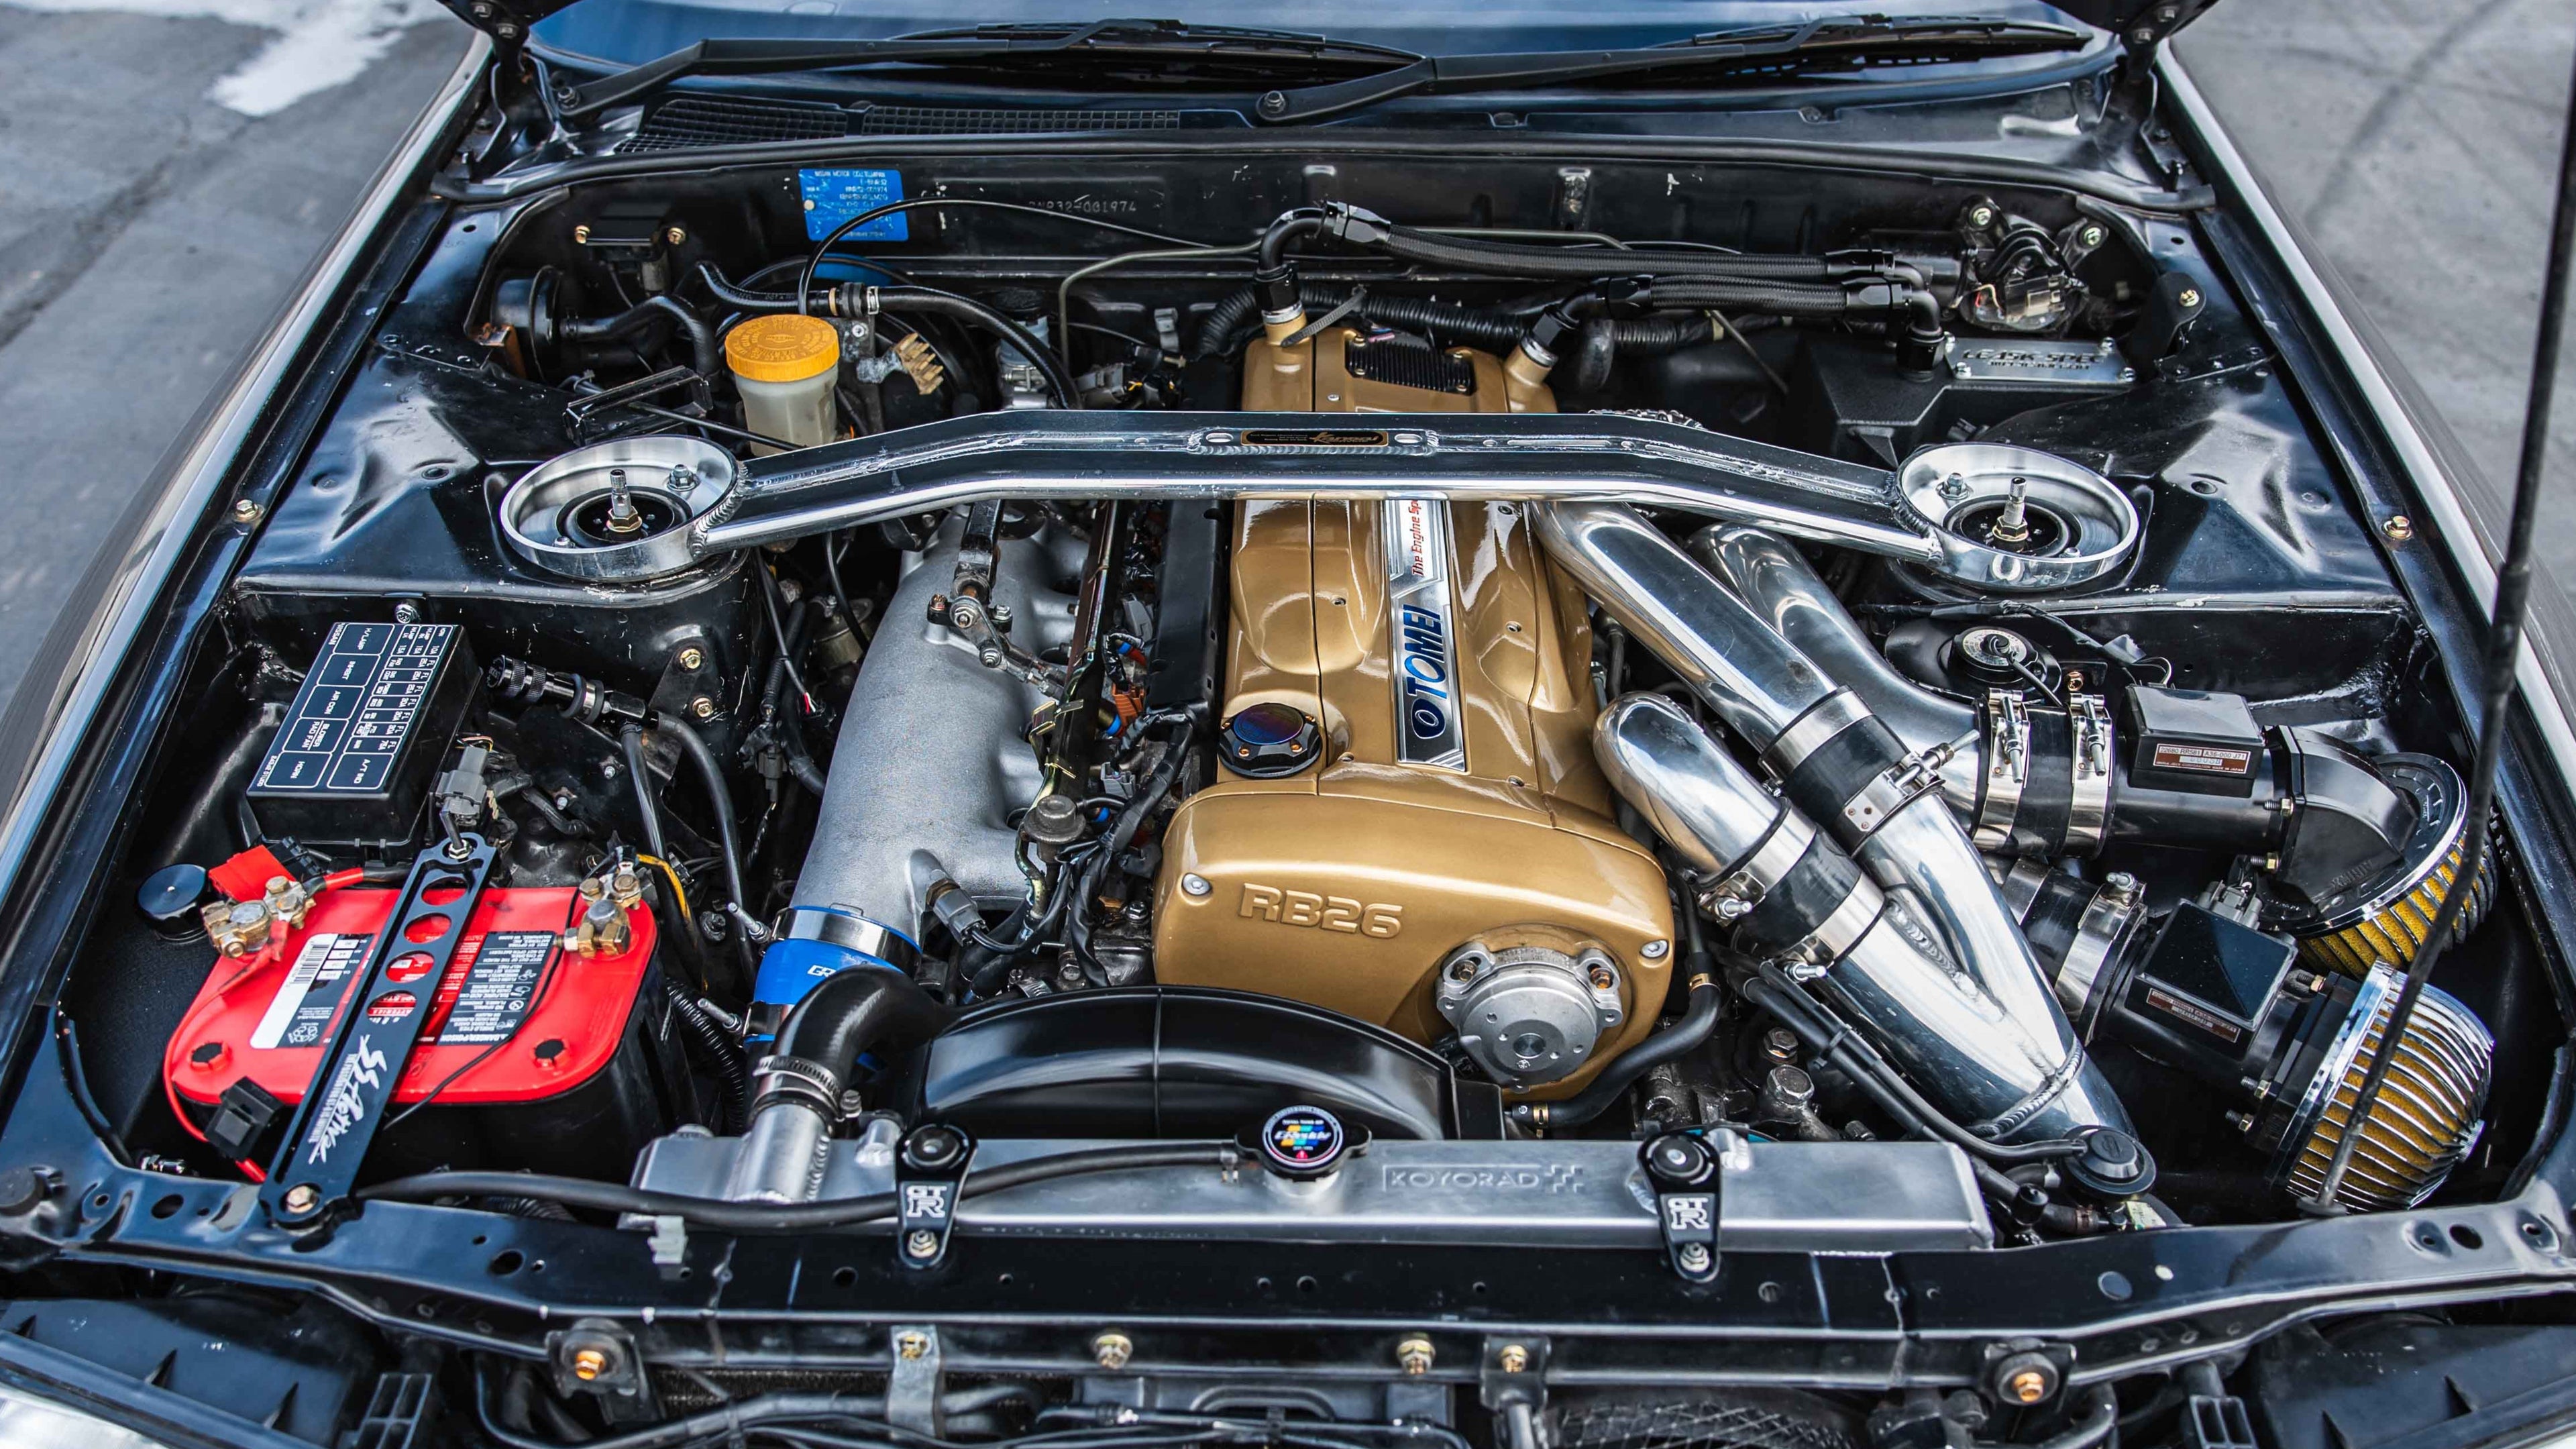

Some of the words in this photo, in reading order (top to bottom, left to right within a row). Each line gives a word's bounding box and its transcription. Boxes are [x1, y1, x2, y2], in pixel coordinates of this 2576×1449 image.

[1962, 349, 2041, 361] LEASK
[2045, 352, 2102, 364] SPEC
[1409, 516, 1424, 555] Engine
[1411, 555, 1425, 577] The
[328, 623, 345, 645] NISSAN
[358, 627, 372, 650] H/LAMP
[429, 645, 440, 655] 10A
[1403, 604, 1448, 699] TOMEI
[331, 690, 341, 701] AIR
[324, 701, 336, 714] CON
[313, 723, 330, 747] BLOWER
[394, 725, 404, 733] FL
[388, 741, 397, 749] FL
[290, 761, 305, 779] HORN
[359, 758, 371, 772] A/T
[1238, 882, 1404, 939] RB26
[1391, 1170, 1540, 1188] KOYORAD
[906, 1185, 948, 1199] GT
[907, 1196, 945, 1218] R
[1668, 1197, 1709, 1211] GT
[1670, 1208, 1710, 1230] R
